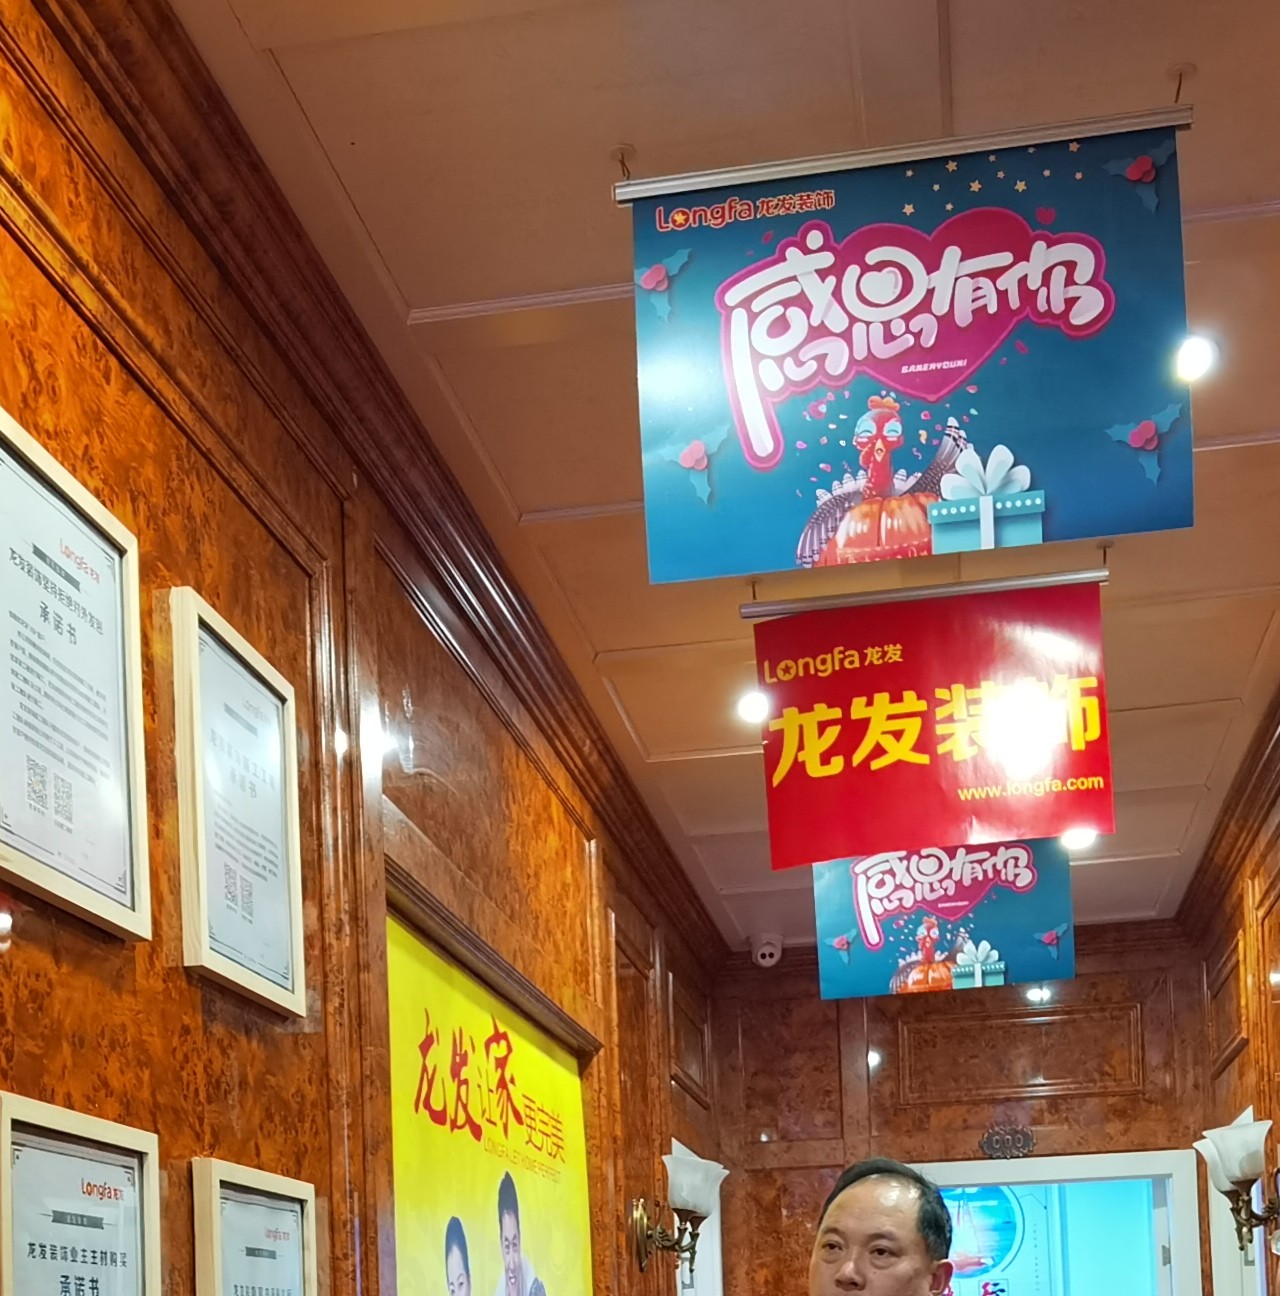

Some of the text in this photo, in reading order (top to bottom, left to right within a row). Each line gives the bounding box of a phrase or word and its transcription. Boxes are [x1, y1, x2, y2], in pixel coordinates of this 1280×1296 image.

[656, 189, 835, 232] Longfa 龙发装饰
[724, 229, 1104, 457] 感恩有你
[763, 643, 904, 684] Longfa 龙发
[768, 673, 1102, 787] 龙发装饰
[957, 775, 1105, 801] www.longfa.com
